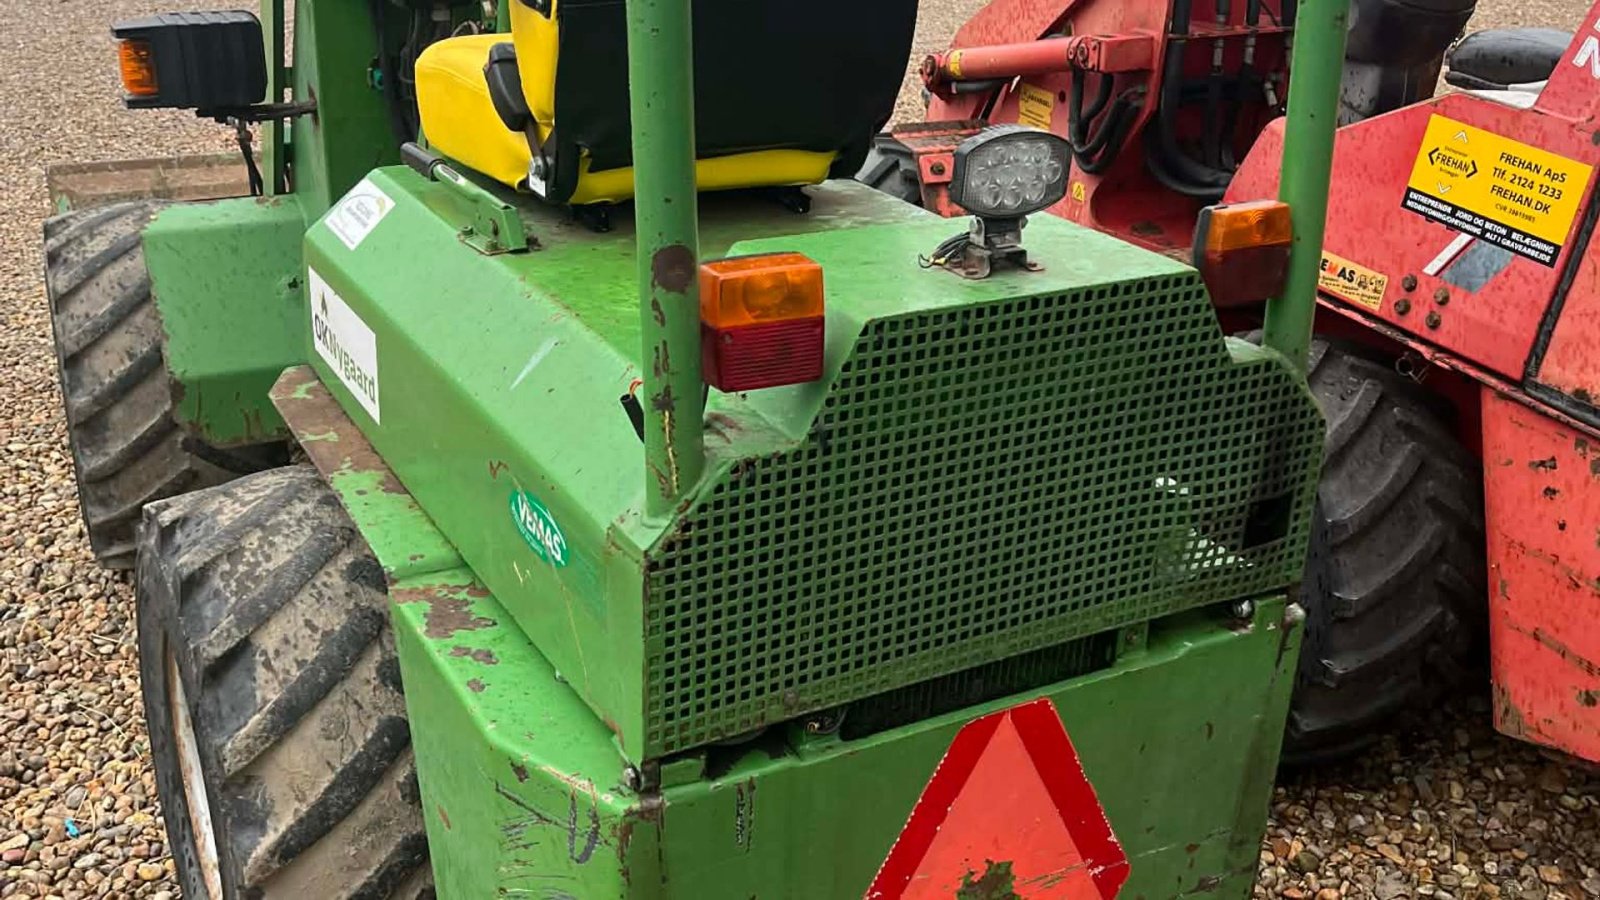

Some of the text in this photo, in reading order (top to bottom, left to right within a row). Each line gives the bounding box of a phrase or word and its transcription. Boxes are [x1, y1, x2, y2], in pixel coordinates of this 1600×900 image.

[1436, 152, 1470, 173] FREHAN
[1499, 152, 1567, 183] FREHAN ApS
[1490, 184, 1551, 214] FREHAN.DK
[1492, 167, 1563, 200] Tlf. 2124 1233
[1455, 209, 1473, 222] JORD
[1473, 217, 1485, 227] OG
[1484, 220, 1507, 236] BETON
[1511, 231, 1555, 254] BELÆGNING
[1485, 232, 1498, 241] ALT
[1501, 238, 1551, 263] GRAVEARBEJDE
[1320, 258, 1355, 283] EMAS
[314, 312, 376, 404] OKNygaard
[517, 493, 562, 562] VEMAS
